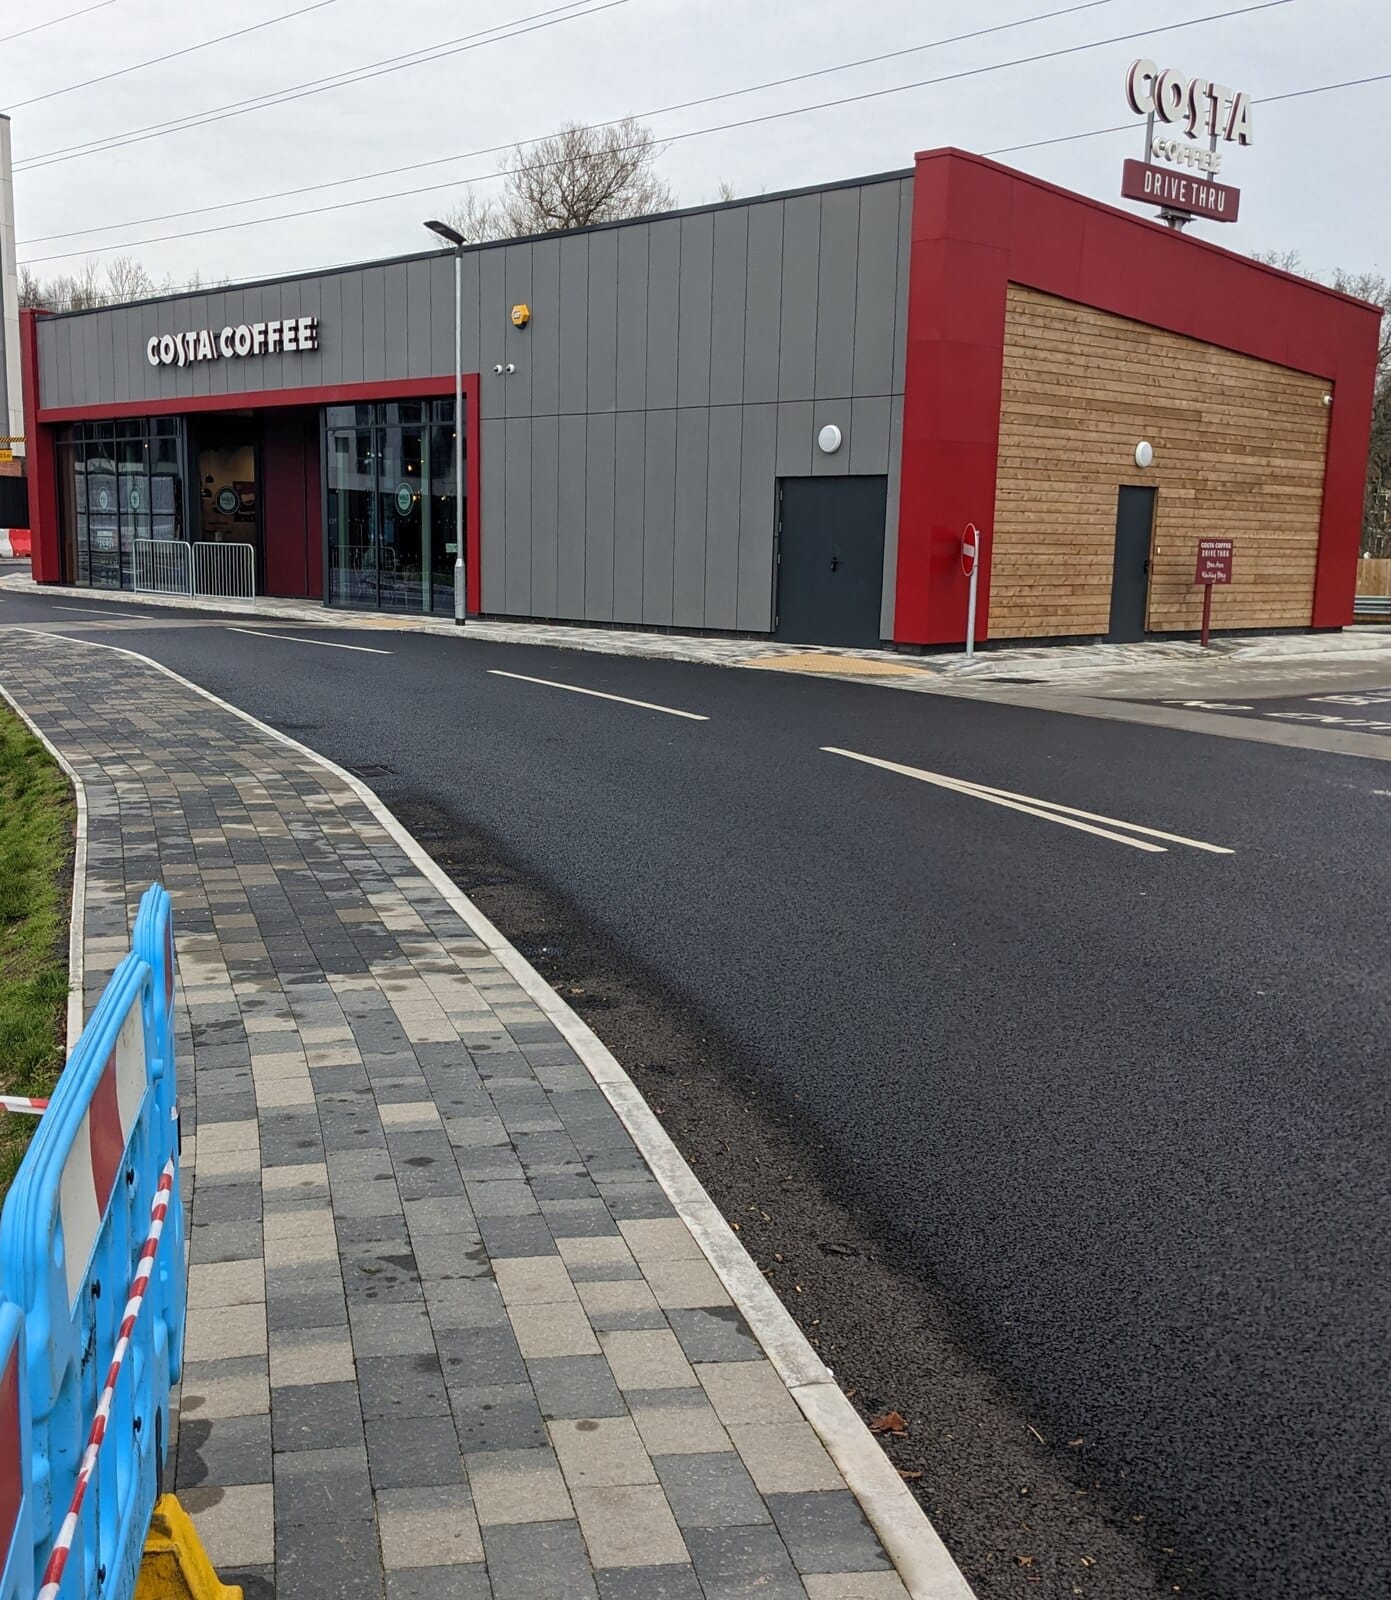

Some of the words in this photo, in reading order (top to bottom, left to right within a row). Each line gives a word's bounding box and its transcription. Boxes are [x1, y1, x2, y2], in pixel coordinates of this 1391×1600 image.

[1126, 58, 1253, 146] COSTA
[1152, 136, 1222, 174] COFFEE
[1144, 171, 1187, 202] DRIVE
[1192, 183, 1226, 212] THRU
[147, 330, 217, 367] COSTA
[219, 316, 319, 358] COFFEE
